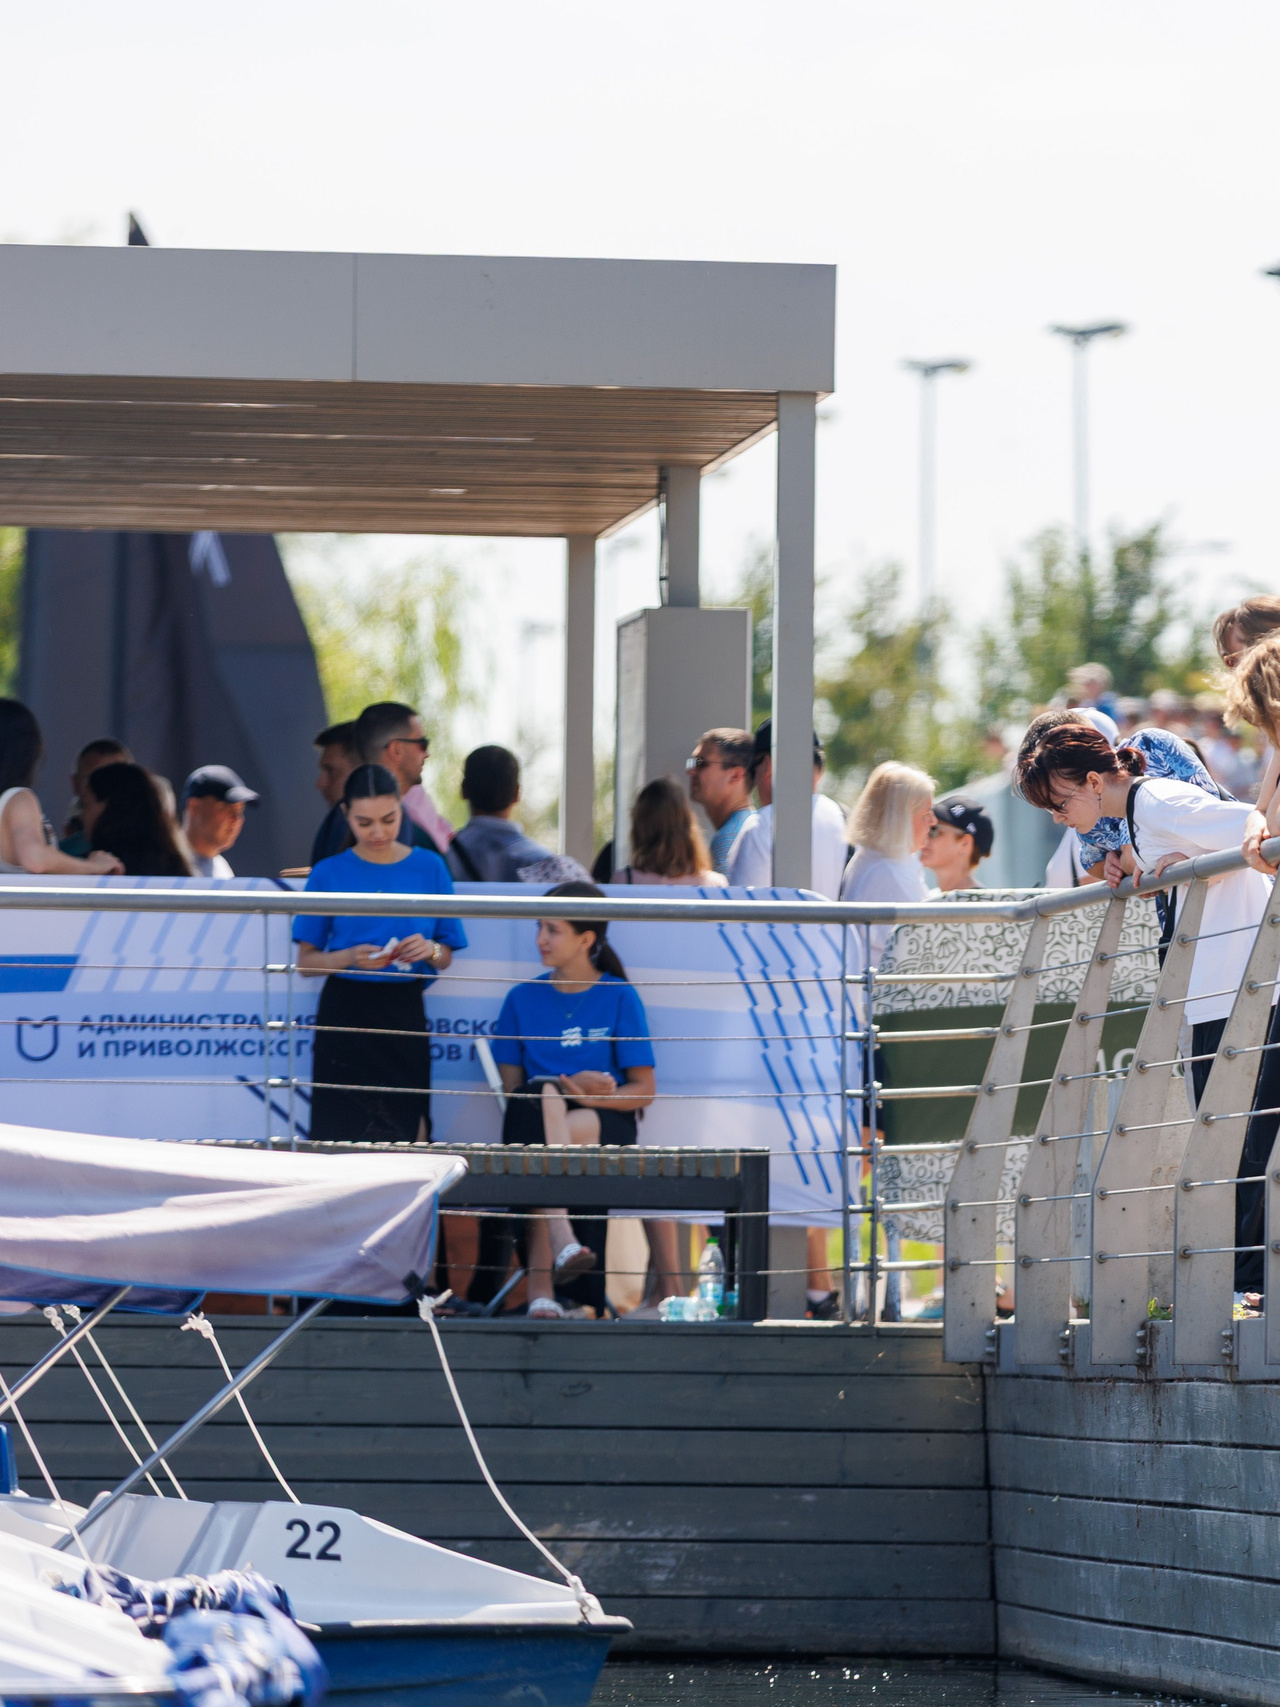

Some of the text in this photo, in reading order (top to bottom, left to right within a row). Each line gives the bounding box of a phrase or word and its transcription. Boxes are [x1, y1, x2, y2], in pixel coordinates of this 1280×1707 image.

[78, 1039, 314, 1058] И ПРИВОЛЖСКОГ
[285, 1518, 342, 1561] 22
